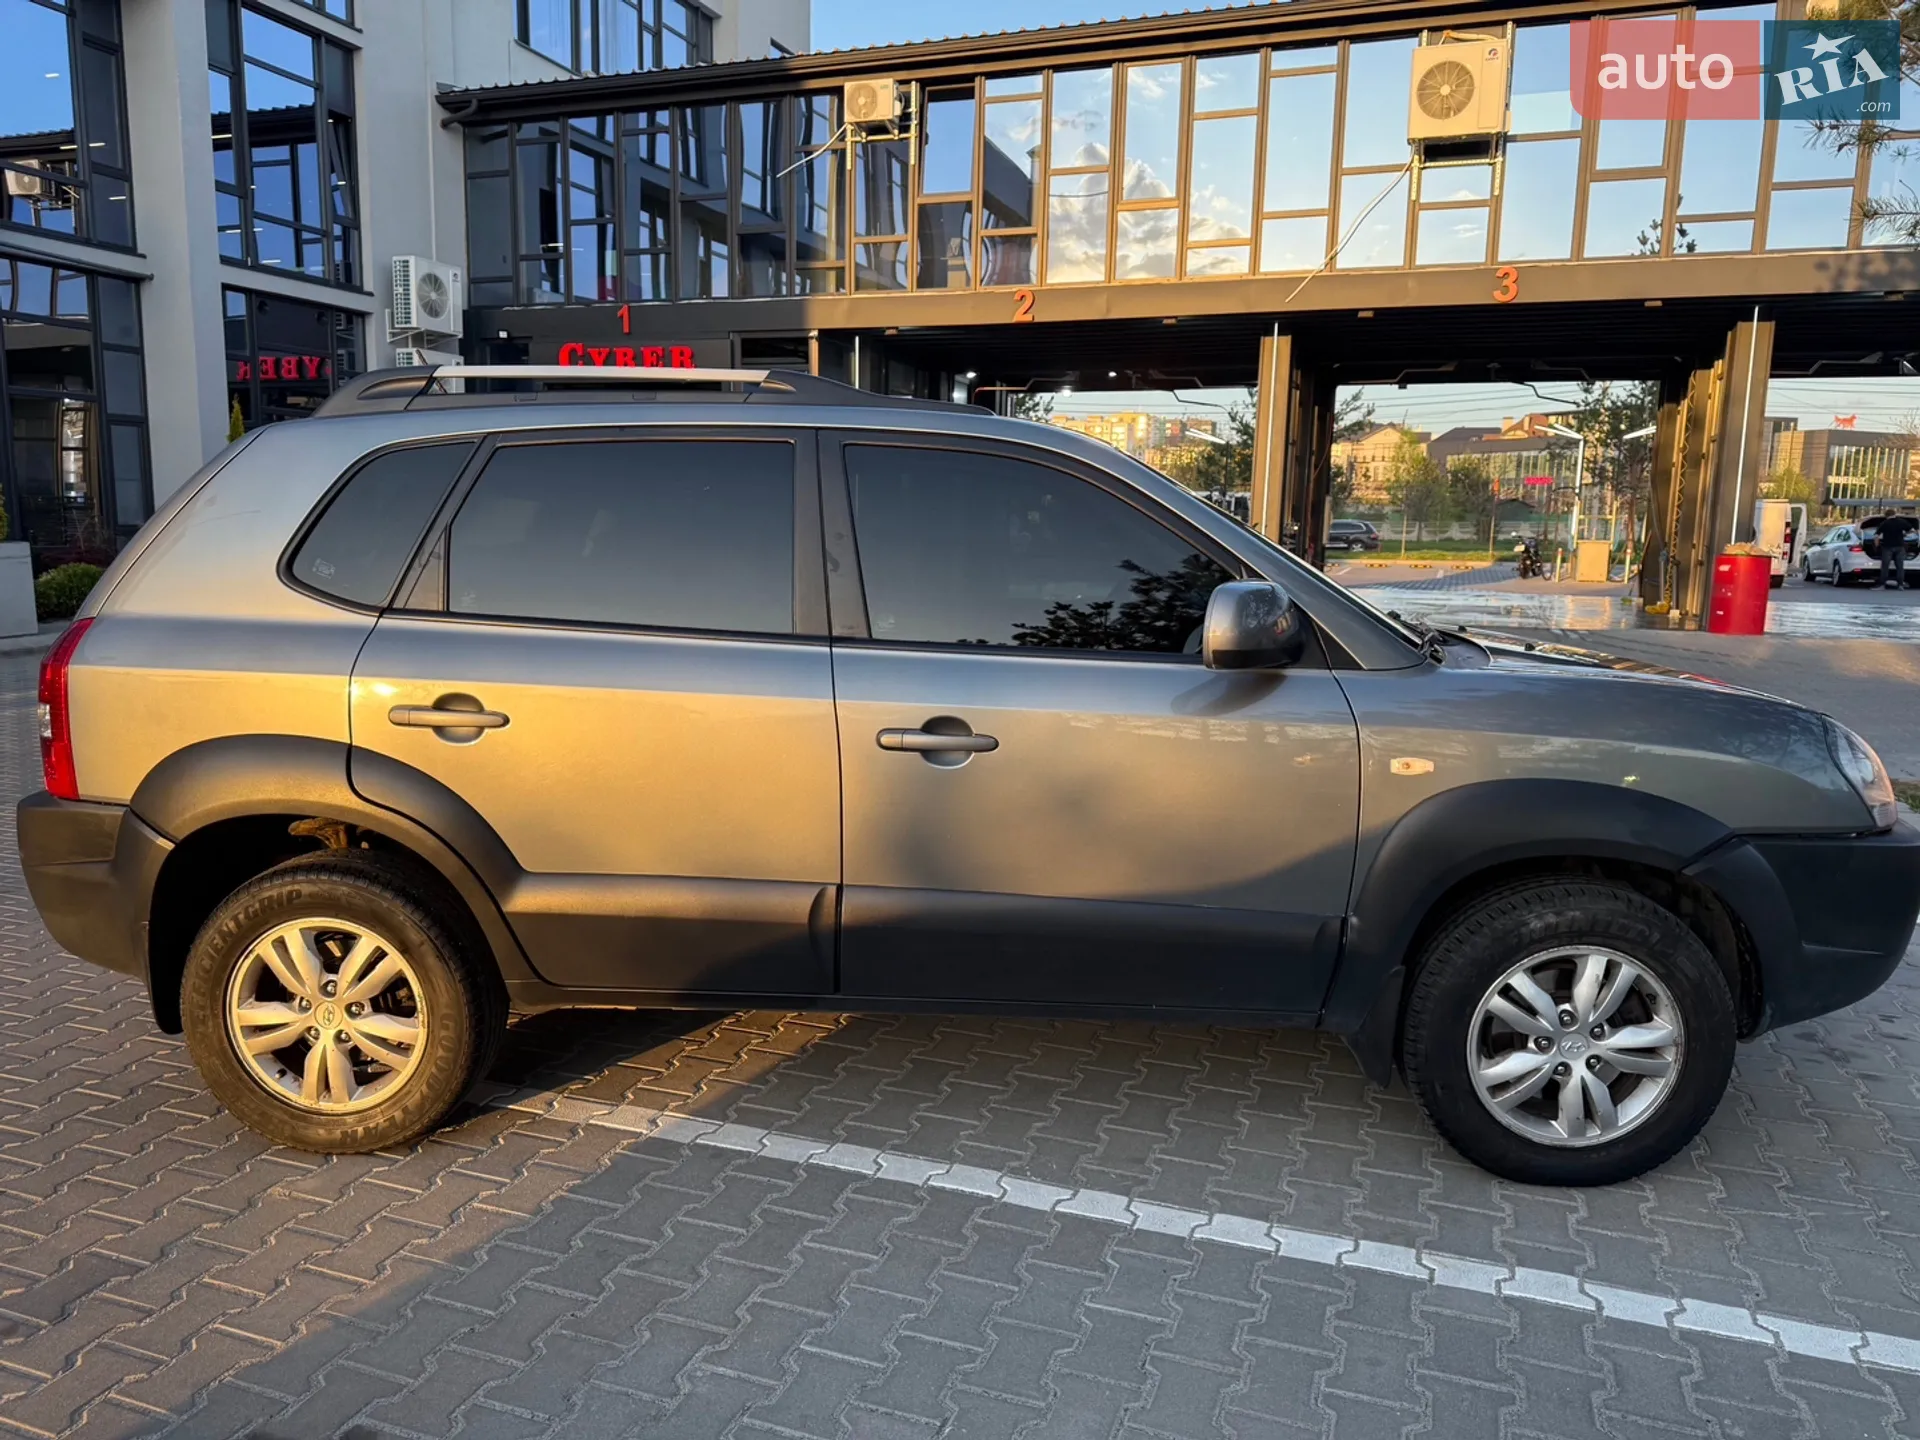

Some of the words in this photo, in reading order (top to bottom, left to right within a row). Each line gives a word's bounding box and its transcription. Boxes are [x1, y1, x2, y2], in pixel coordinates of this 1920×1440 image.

[1493, 266, 1519, 303] 3
[617, 304, 631, 334] 1
[1012, 289, 1035, 323] 2
[558, 342, 696, 369] CYBER
